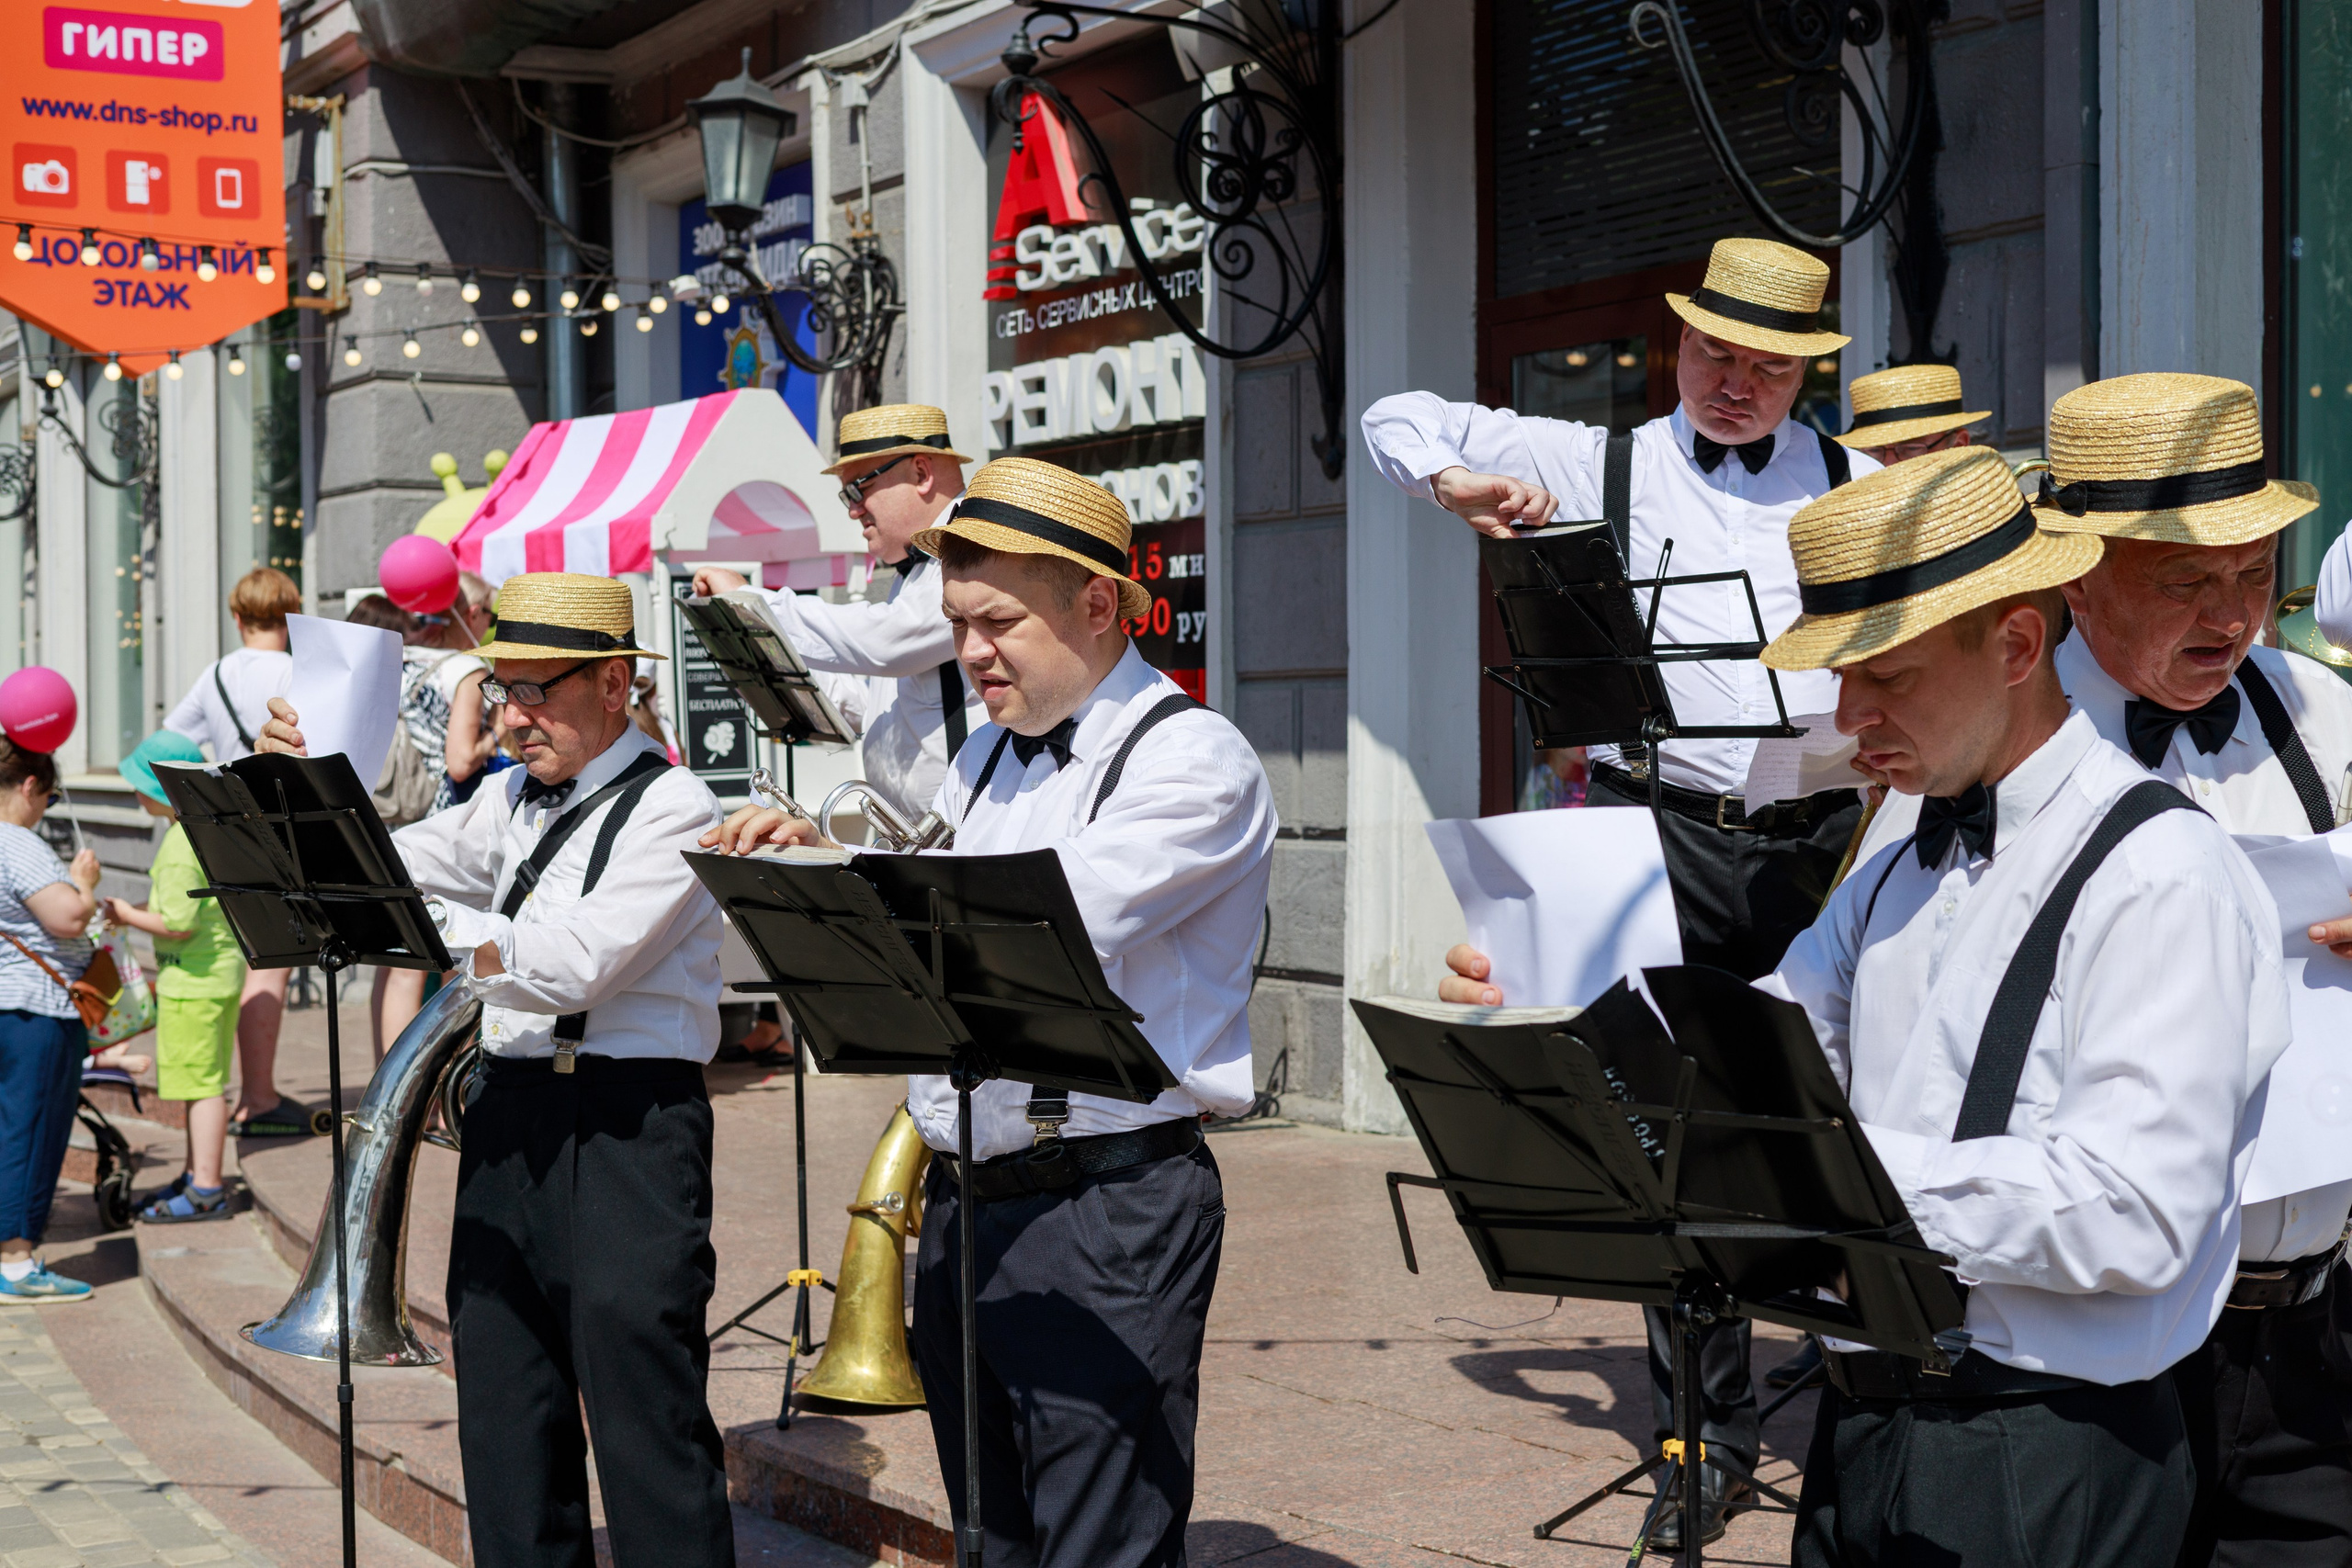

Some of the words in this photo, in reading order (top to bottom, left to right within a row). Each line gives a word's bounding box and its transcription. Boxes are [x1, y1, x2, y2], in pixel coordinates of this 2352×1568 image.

[62, 21, 209, 66] ГИПЕР
[22, 96, 258, 136] www.dns-shop.ru
[1015, 197, 1204, 292] Service
[94, 279, 191, 310] ЭТАЖ
[995, 309, 1035, 339] СЕТЬ
[1036, 283, 1136, 330] СЕРВИСНЫХ
[1139, 267, 1205, 311] ЦНТРО
[982, 330, 1207, 451] РЕМОНТ
[1128, 541, 1164, 581] 15
